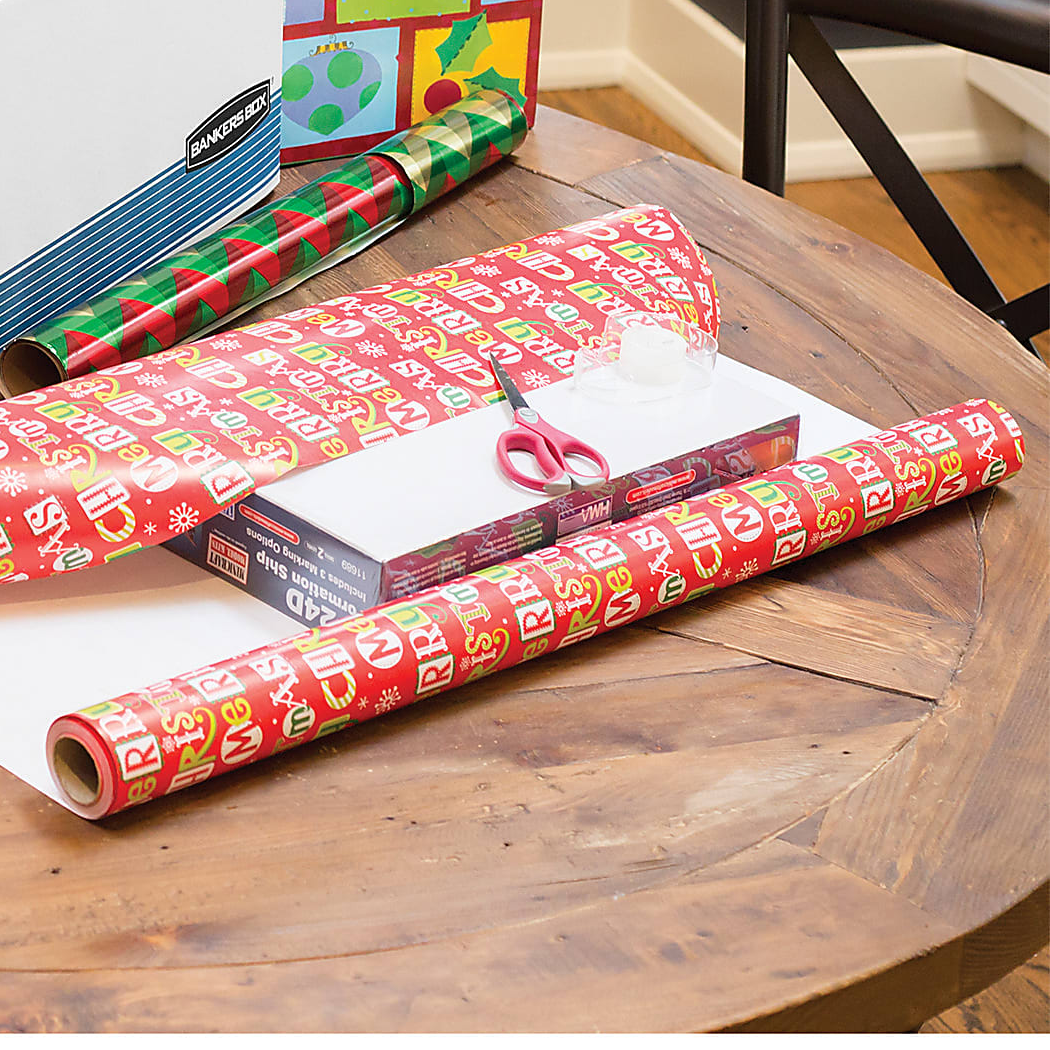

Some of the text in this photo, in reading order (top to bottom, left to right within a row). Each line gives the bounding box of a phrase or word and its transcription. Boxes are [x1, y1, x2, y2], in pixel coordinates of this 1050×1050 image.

[190, 93, 267, 159] BANKERS BOX
[581, 500, 610, 522] HMA
[247, 527, 280, 555] Options
[209, 550, 247, 581] MINICRAFT
[256, 550, 288, 579] Ship
[282, 545, 315, 574] Marking
[328, 572, 366, 603] Includes
